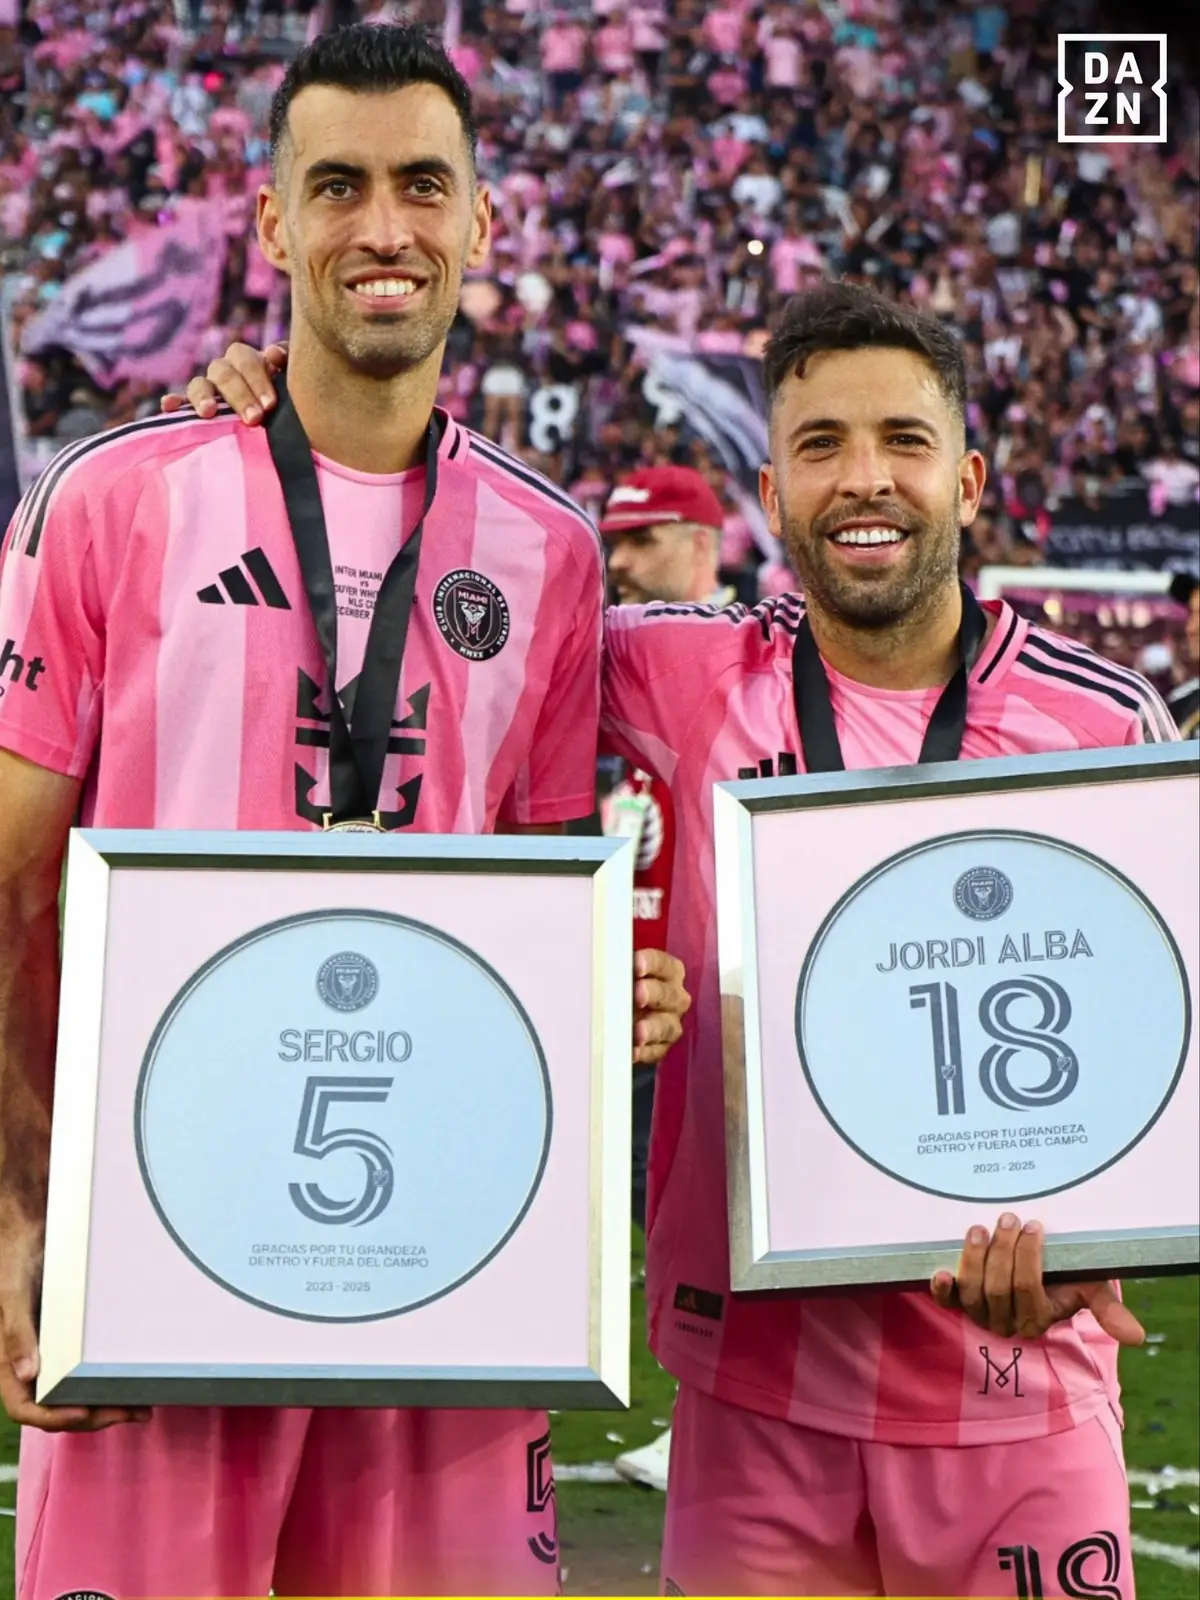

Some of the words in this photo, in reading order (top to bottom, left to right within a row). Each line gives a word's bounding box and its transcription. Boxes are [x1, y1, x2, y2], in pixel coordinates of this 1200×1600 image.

[335, 566, 356, 577] INTER
[359, 570, 382, 580] MIAMI
[437, 571, 497, 602] INTERNACIONAL
[348, 597, 363, 608] MLS
[458, 590, 488, 604] MIAMI
[436, 606, 448, 632] CLUB
[876, 936, 985, 973] JORDI
[998, 928, 1094, 964] ALBA
[278, 1028, 413, 1063] SERGIO
[909, 974, 1079, 1115] 18
[918, 1131, 971, 1143] GRACIAS
[974, 1129, 998, 1140] POR
[1001, 1128, 1017, 1138] TU
[1019, 1124, 1085, 1137] GRANDEZA
[288, 1076, 395, 1228] 5
[917, 1143, 966, 1155] DENTRO
[968, 1141, 976, 1150] Y
[978, 1139, 1017, 1150] FUERA
[1019, 1138, 1042, 1148] DEL
[1044, 1135, 1088, 1146] CAMPO
[973, 1163, 1000, 1174] 2023
[1009, 1161, 1035, 1171] 2025
[252, 1244, 307, 1254] GRACIAS
[310, 1244, 336, 1254] POR
[339, 1245, 356, 1254] TU
[357, 1245, 427, 1255] GRANDEZA
[249, 1256, 300, 1266] DENTRO
[300, 1256, 309, 1266] Y
[313, 1256, 354, 1267] FUERA
[357, 1257, 380, 1267] DEL
[383, 1257, 429, 1268] CAMPO
[305, 1281, 333, 1292] 2023
[342, 1281, 371, 1292] 2025
